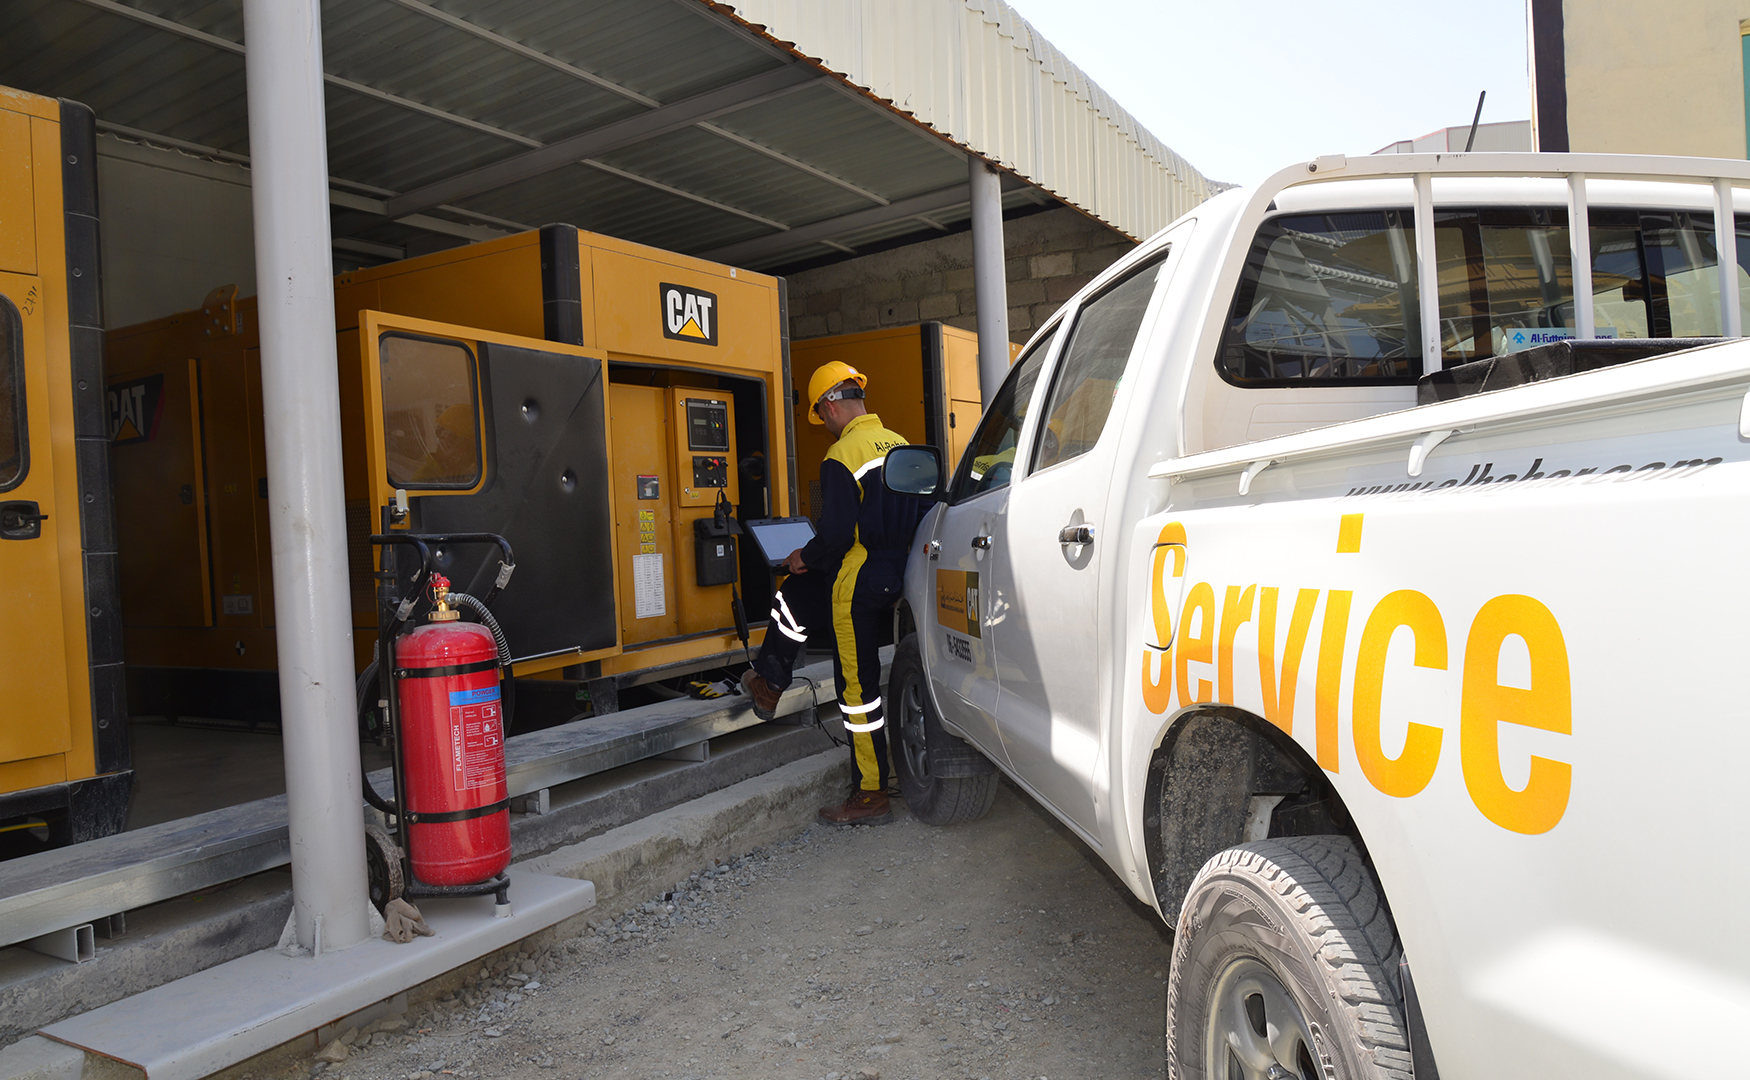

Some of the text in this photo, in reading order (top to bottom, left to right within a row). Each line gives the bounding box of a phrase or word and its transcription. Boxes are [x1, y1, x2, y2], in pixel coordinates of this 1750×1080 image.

[666, 289, 712, 340] CAT
[108, 384, 146, 442] CAT
[966, 587, 979, 621] CAT
[472, 688, 495, 697] POWDER
[1142, 513, 1572, 835] Service
[454, 725, 462, 771] FLAMETECH
